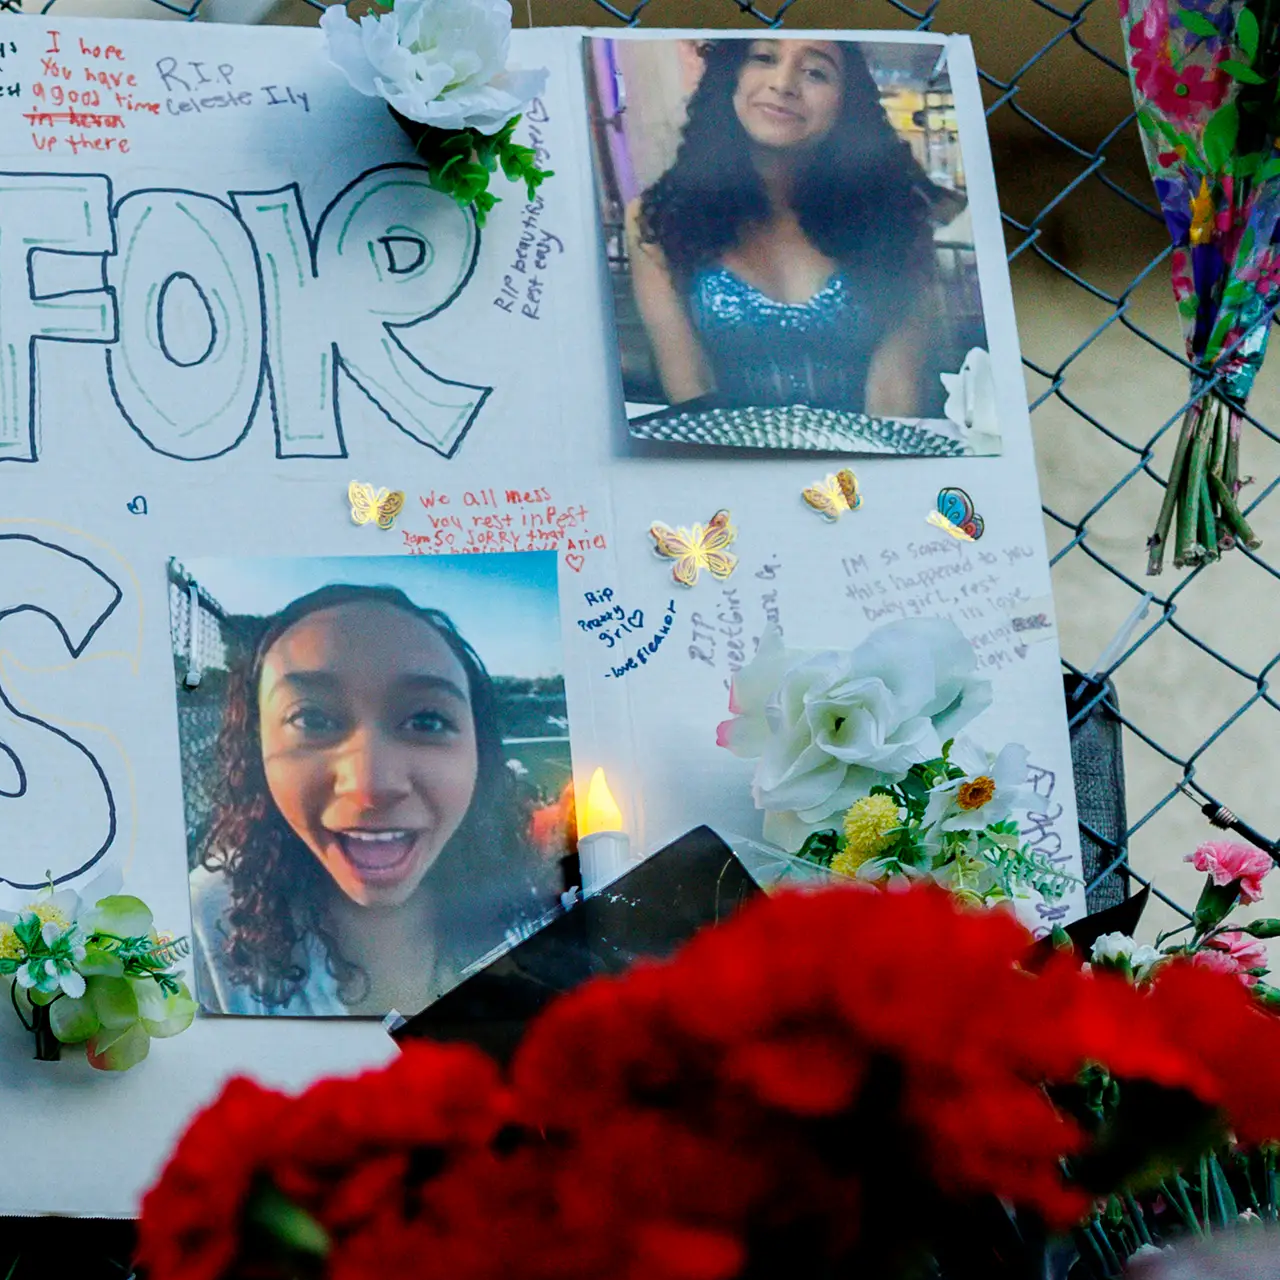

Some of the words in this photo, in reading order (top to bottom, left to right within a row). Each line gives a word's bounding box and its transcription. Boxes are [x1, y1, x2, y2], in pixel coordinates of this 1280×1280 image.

[46, 30, 61, 54] I
[85, 67, 137, 87] have
[116, 90, 161, 115] time
[166, 91, 252, 116] Celeste
[65, 134, 131, 155] there
[493, 274, 519, 313] RIP
[521, 273, 544, 320] Rest
[463, 488, 498, 509] all
[471, 513, 514, 530] rest
[521, 506, 544, 527] in
[598, 624, 632, 648] girl
